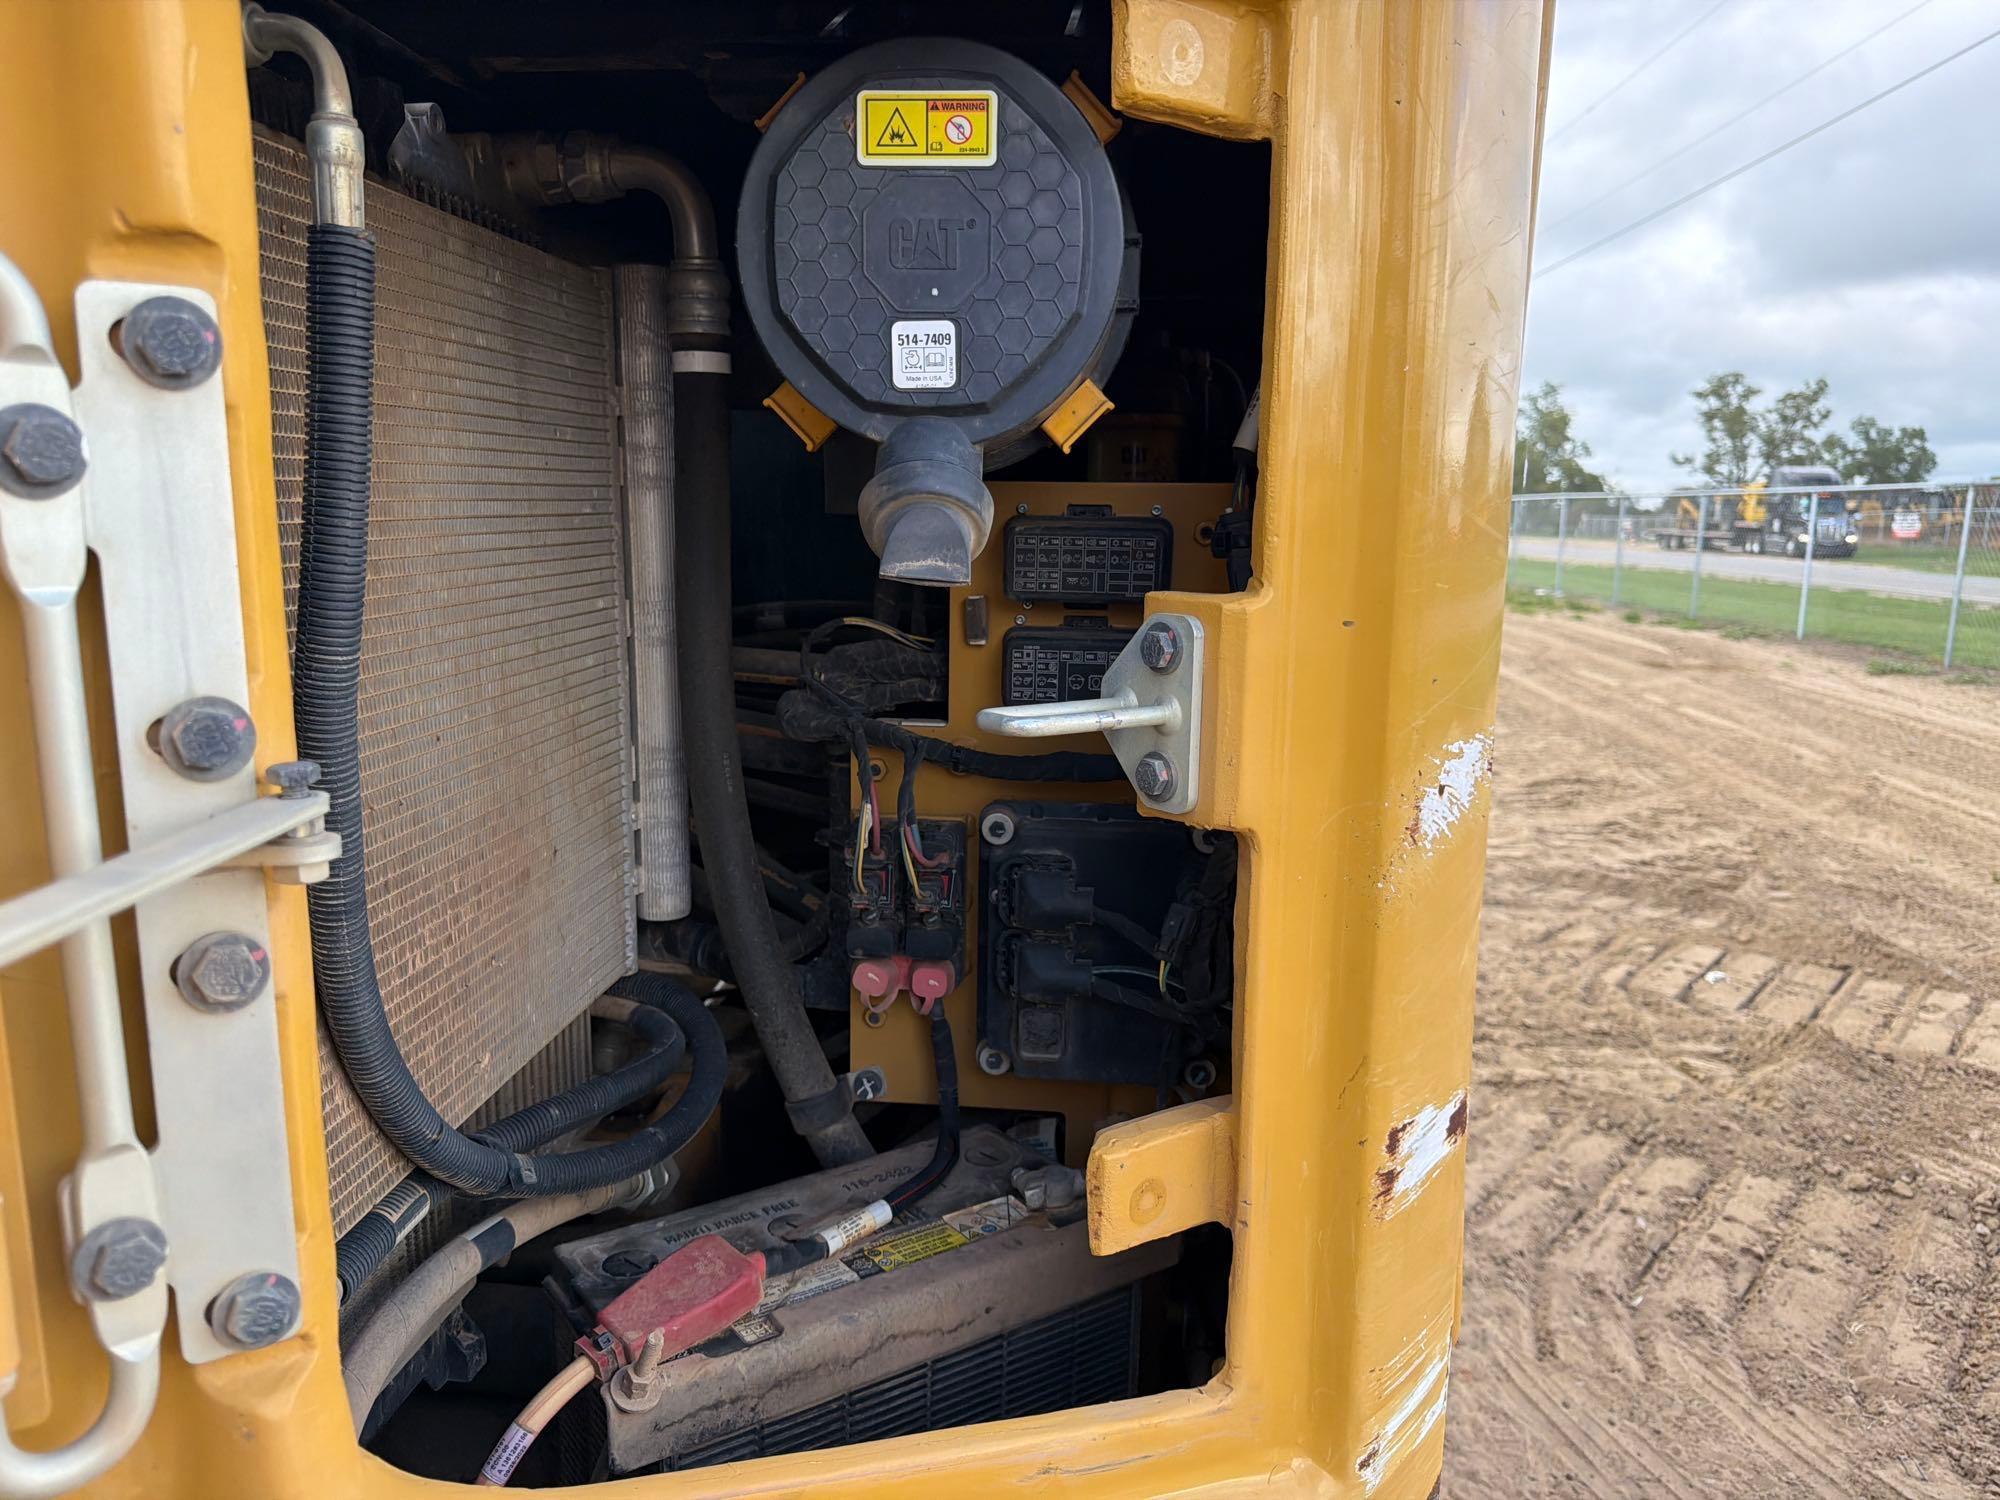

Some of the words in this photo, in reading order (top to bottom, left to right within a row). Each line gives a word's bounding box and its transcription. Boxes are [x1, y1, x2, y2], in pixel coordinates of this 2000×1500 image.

[942, 101, 985, 111] WARNING
[889, 218, 965, 271] CAT
[897, 332, 952, 346] 514-7409
[762, 1198, 800, 1220] FREE
